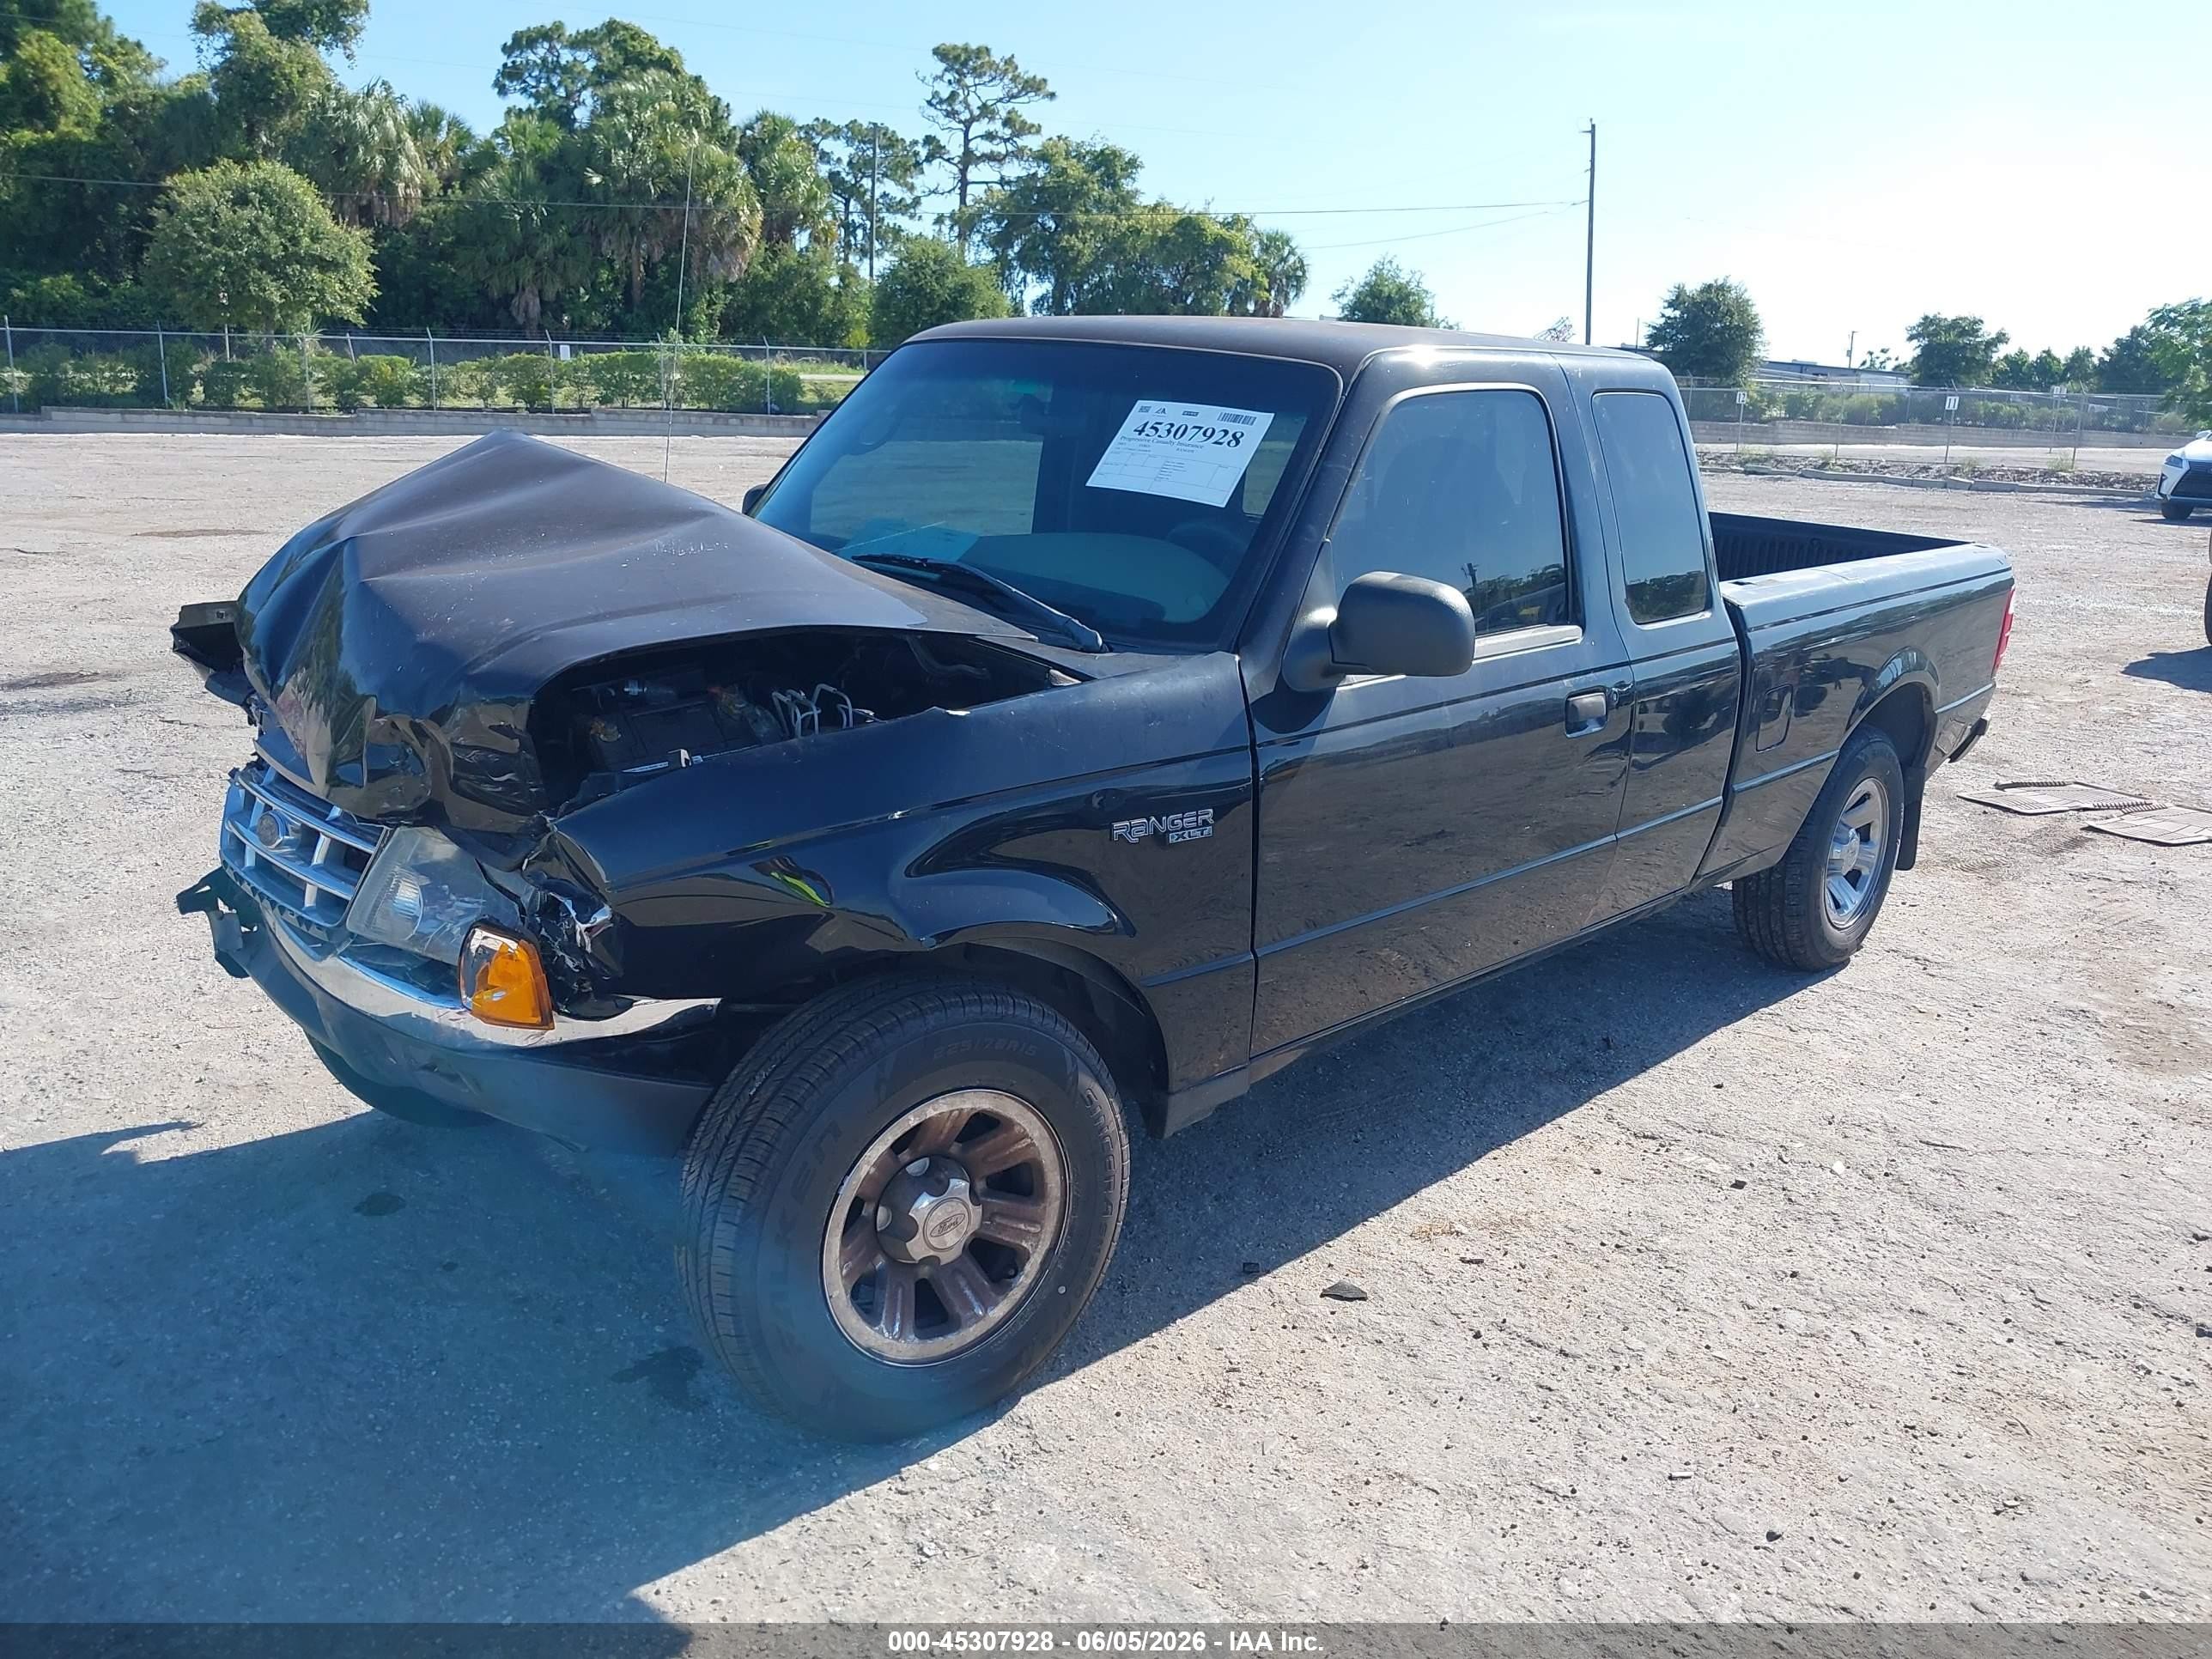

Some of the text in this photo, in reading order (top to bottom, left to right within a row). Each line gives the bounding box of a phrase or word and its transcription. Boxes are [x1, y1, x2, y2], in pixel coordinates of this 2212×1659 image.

[1948, 398, 1957, 409] 11
[1133, 420, 1245, 448] 45307928
[1171, 826, 1212, 842] XLT
